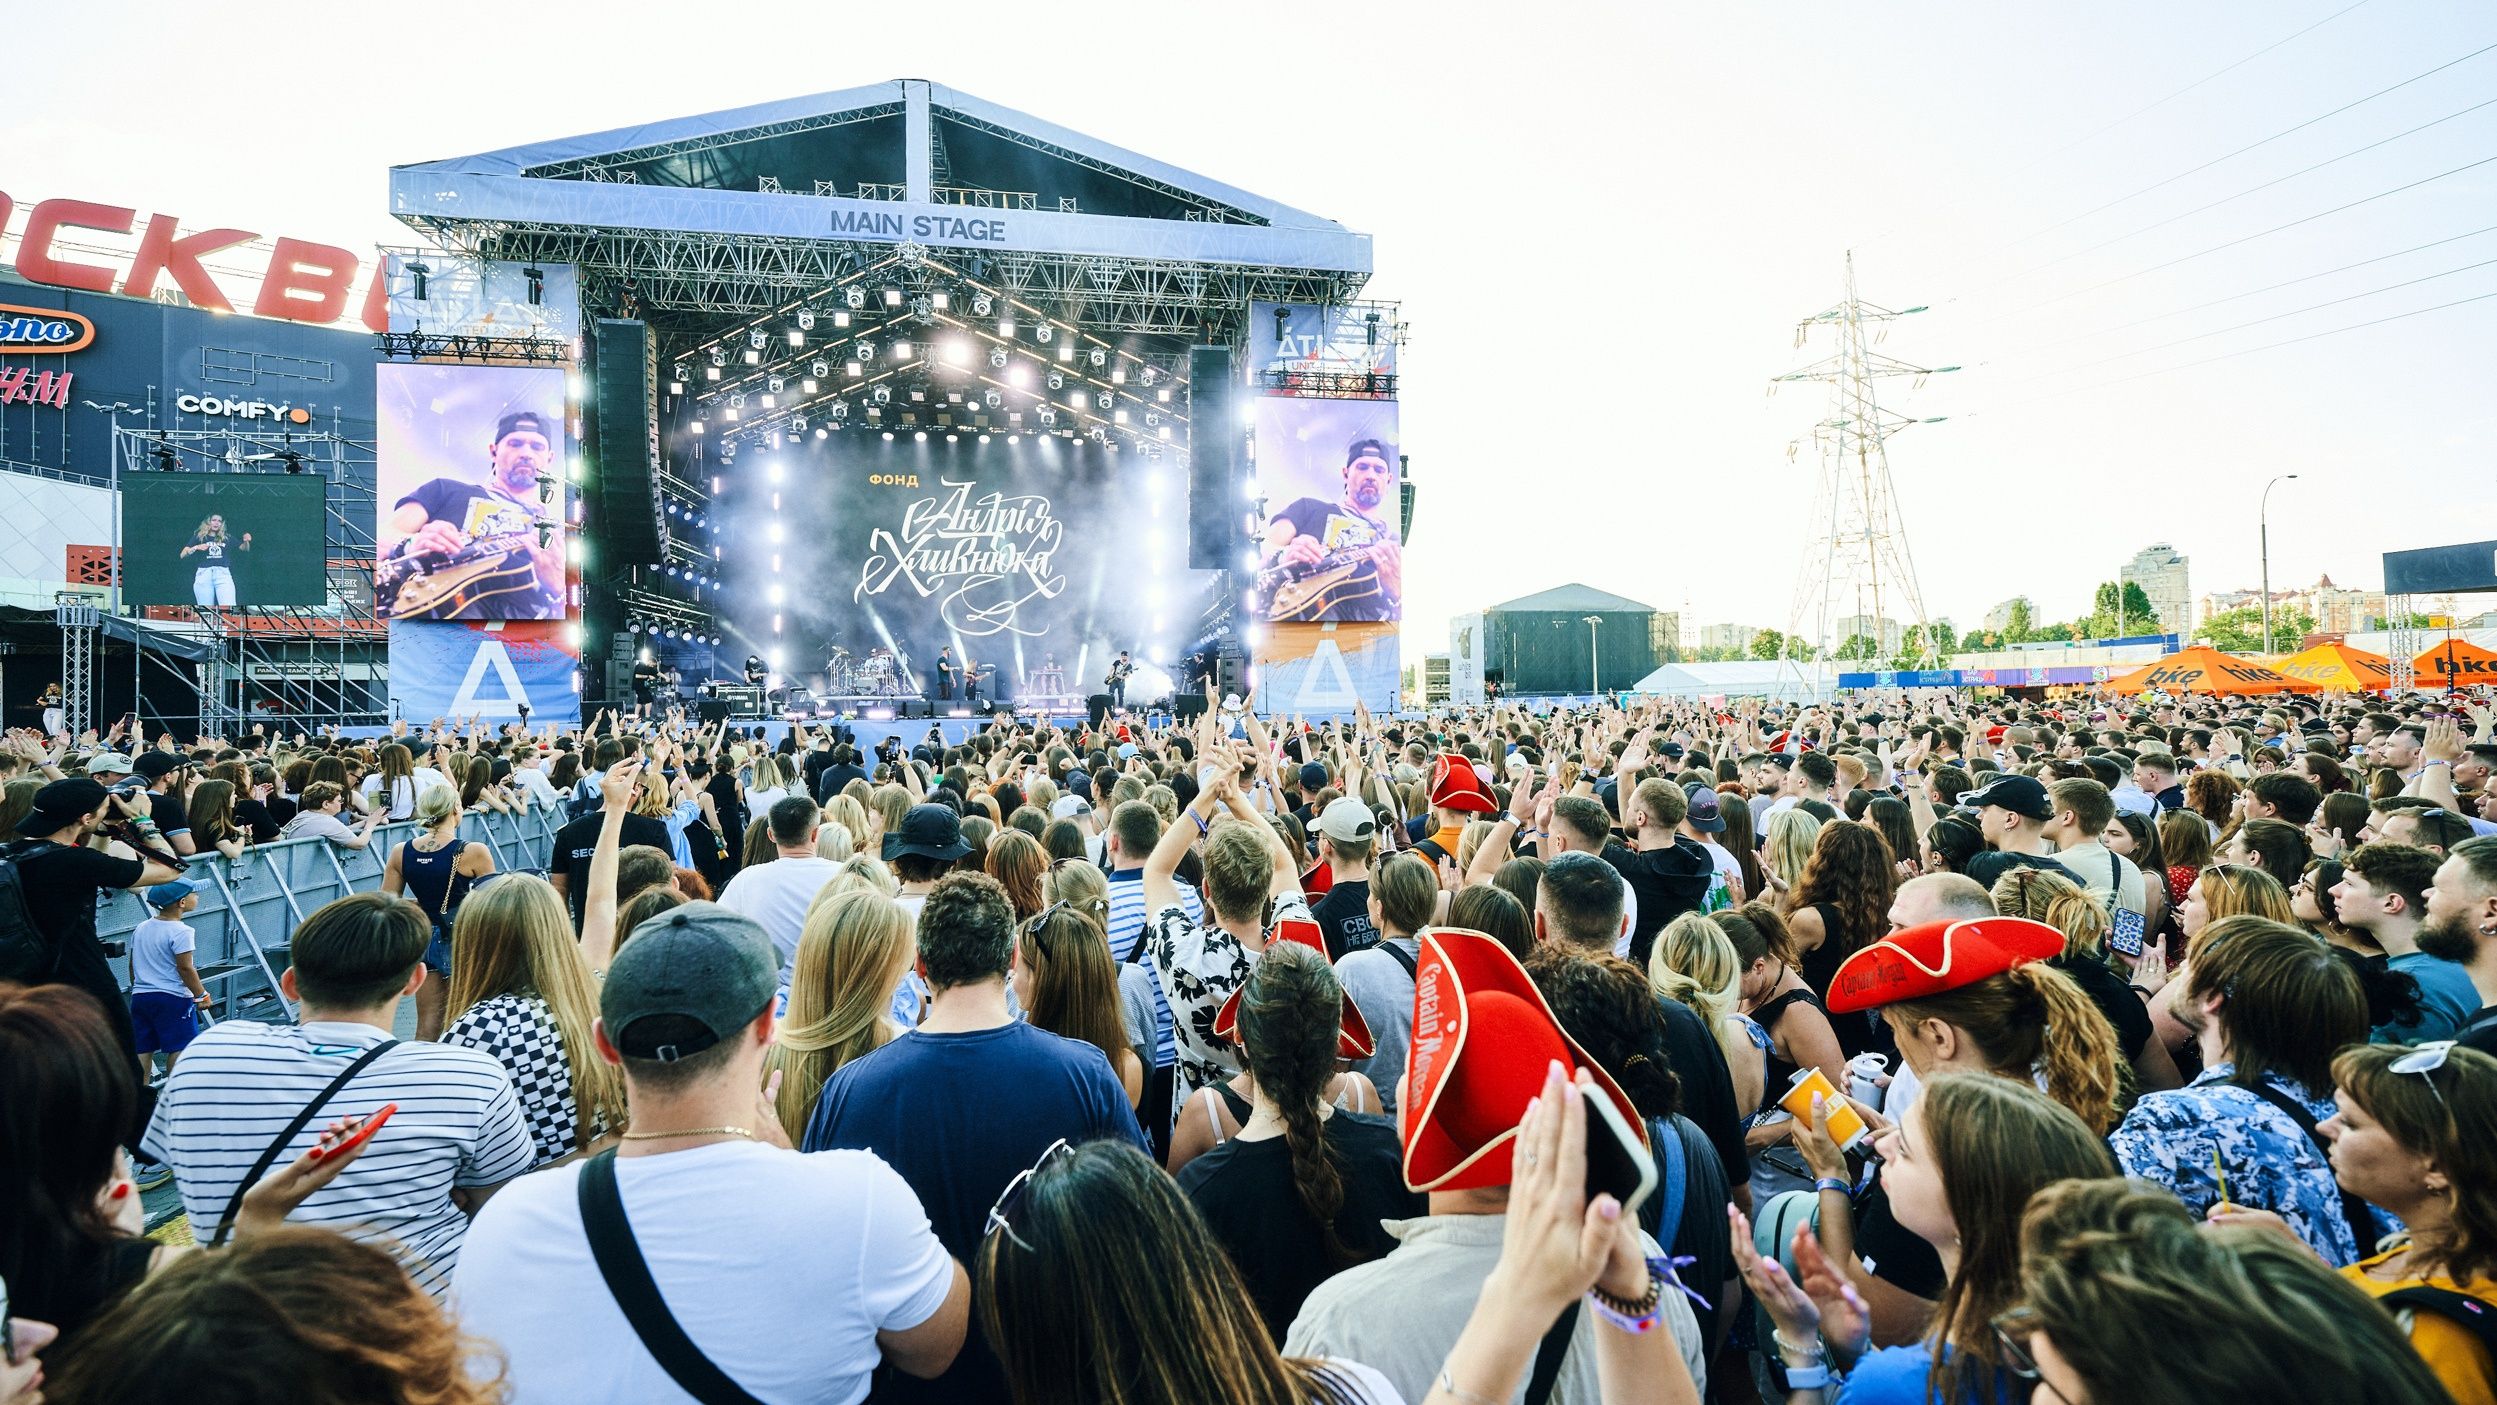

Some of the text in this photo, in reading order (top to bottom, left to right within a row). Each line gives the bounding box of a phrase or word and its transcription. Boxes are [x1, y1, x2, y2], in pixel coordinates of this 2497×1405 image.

[831, 210, 1006, 242] MAIN STAGE
[0, 190, 389, 332] CKB
[0, 366, 73, 409] H&M
[177, 394, 288, 422] COMFY
[869, 475, 919, 488] ФОНД
[1418, 962, 1444, 1036] Captain
[1841, 971, 1877, 997] Captain
